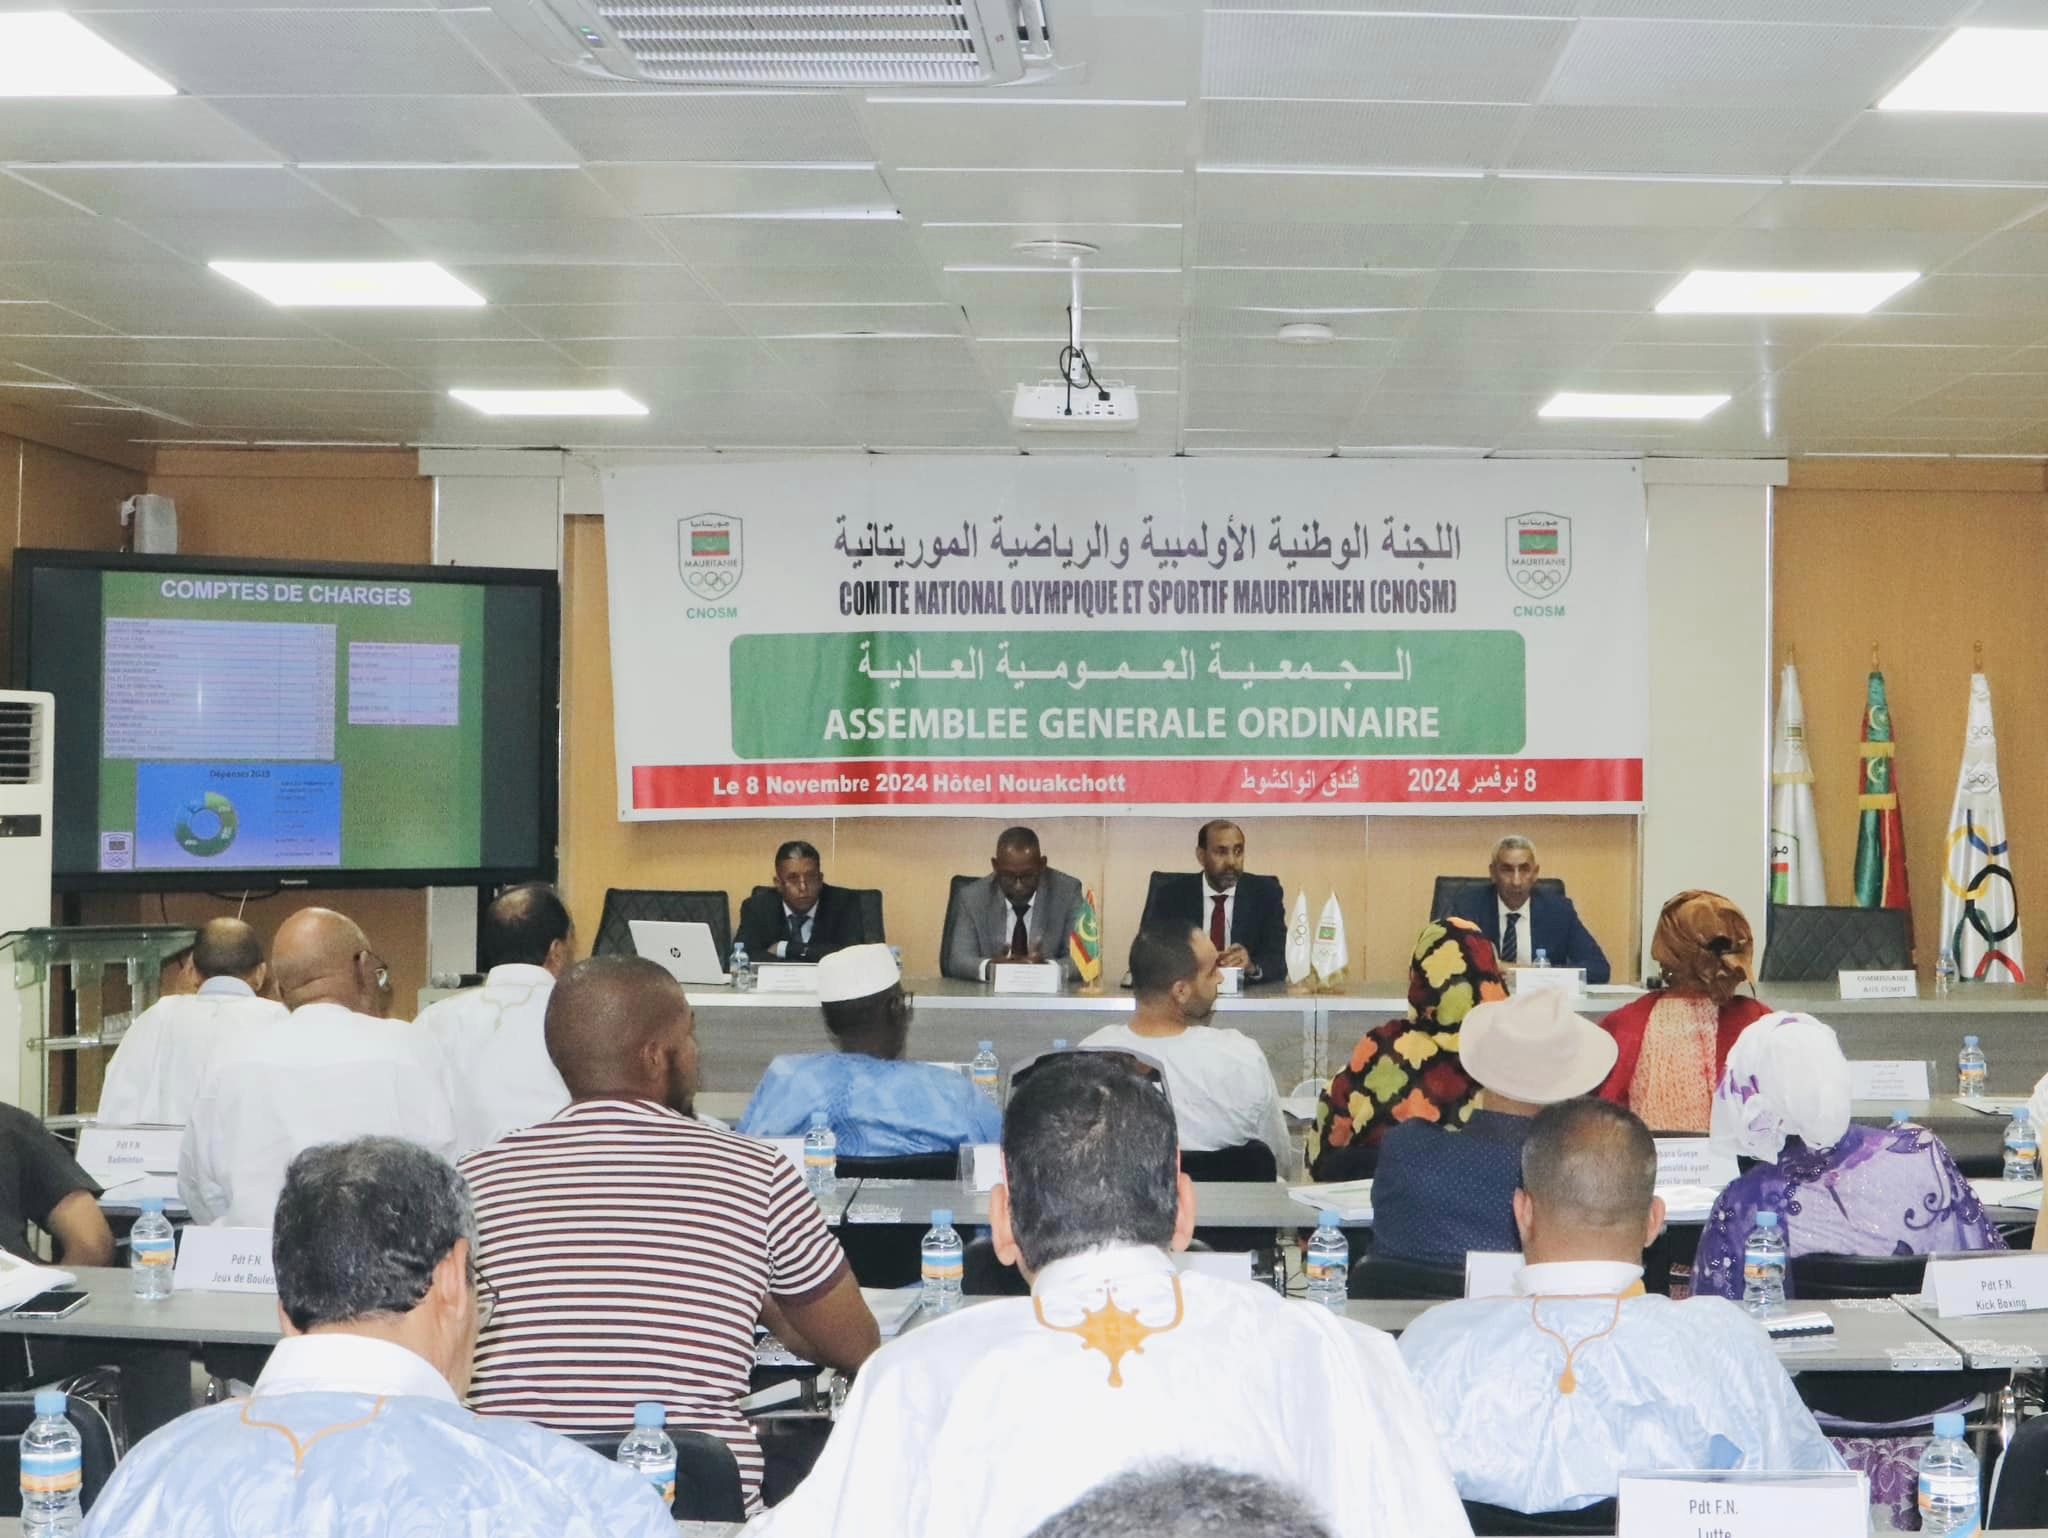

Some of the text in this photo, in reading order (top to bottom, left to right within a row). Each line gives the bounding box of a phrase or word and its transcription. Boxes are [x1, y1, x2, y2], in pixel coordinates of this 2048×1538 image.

[833, 514, 1461, 570] اللجنة الوطنية الأولمبية والرياضية الموريتانية
[684, 559, 737, 568] MAURITANIE
[1512, 558, 1566, 566] MAURITANIE
[161, 579, 412, 606] COMPTES DE CHARGES
[839, 579, 1457, 618] COMITE NATIONAL OLYMPIQUE ET SPORTIF MAURITANIEN (CNOSM)
[686, 607, 738, 619] CNOSM
[1513, 605, 1566, 617] CNOSM
[858, 639, 1412, 690] الجمعية العمومية العادية
[823, 706, 1441, 740] ASSEMBLEE GENERALE ORDINAIRE
[713, 771, 1127, 796] Le 8 Novembre 2024 Hôtel Nouakchott
[1321, 765, 1361, 798] فندق
[1407, 767, 1461, 792] 2024
[1466, 765, 1519, 795] نوفمبر
[1524, 767, 1537, 792] 8
[231, 1253, 246, 1265] Pdt
[211, 1272, 275, 1285] Jeux de Boules
[1981, 1280, 1997, 1291] Pdt
[1976, 1298, 2028, 1311] Kick Boxing
[1689, 1499, 1739, 1515] Pdt F.N.
